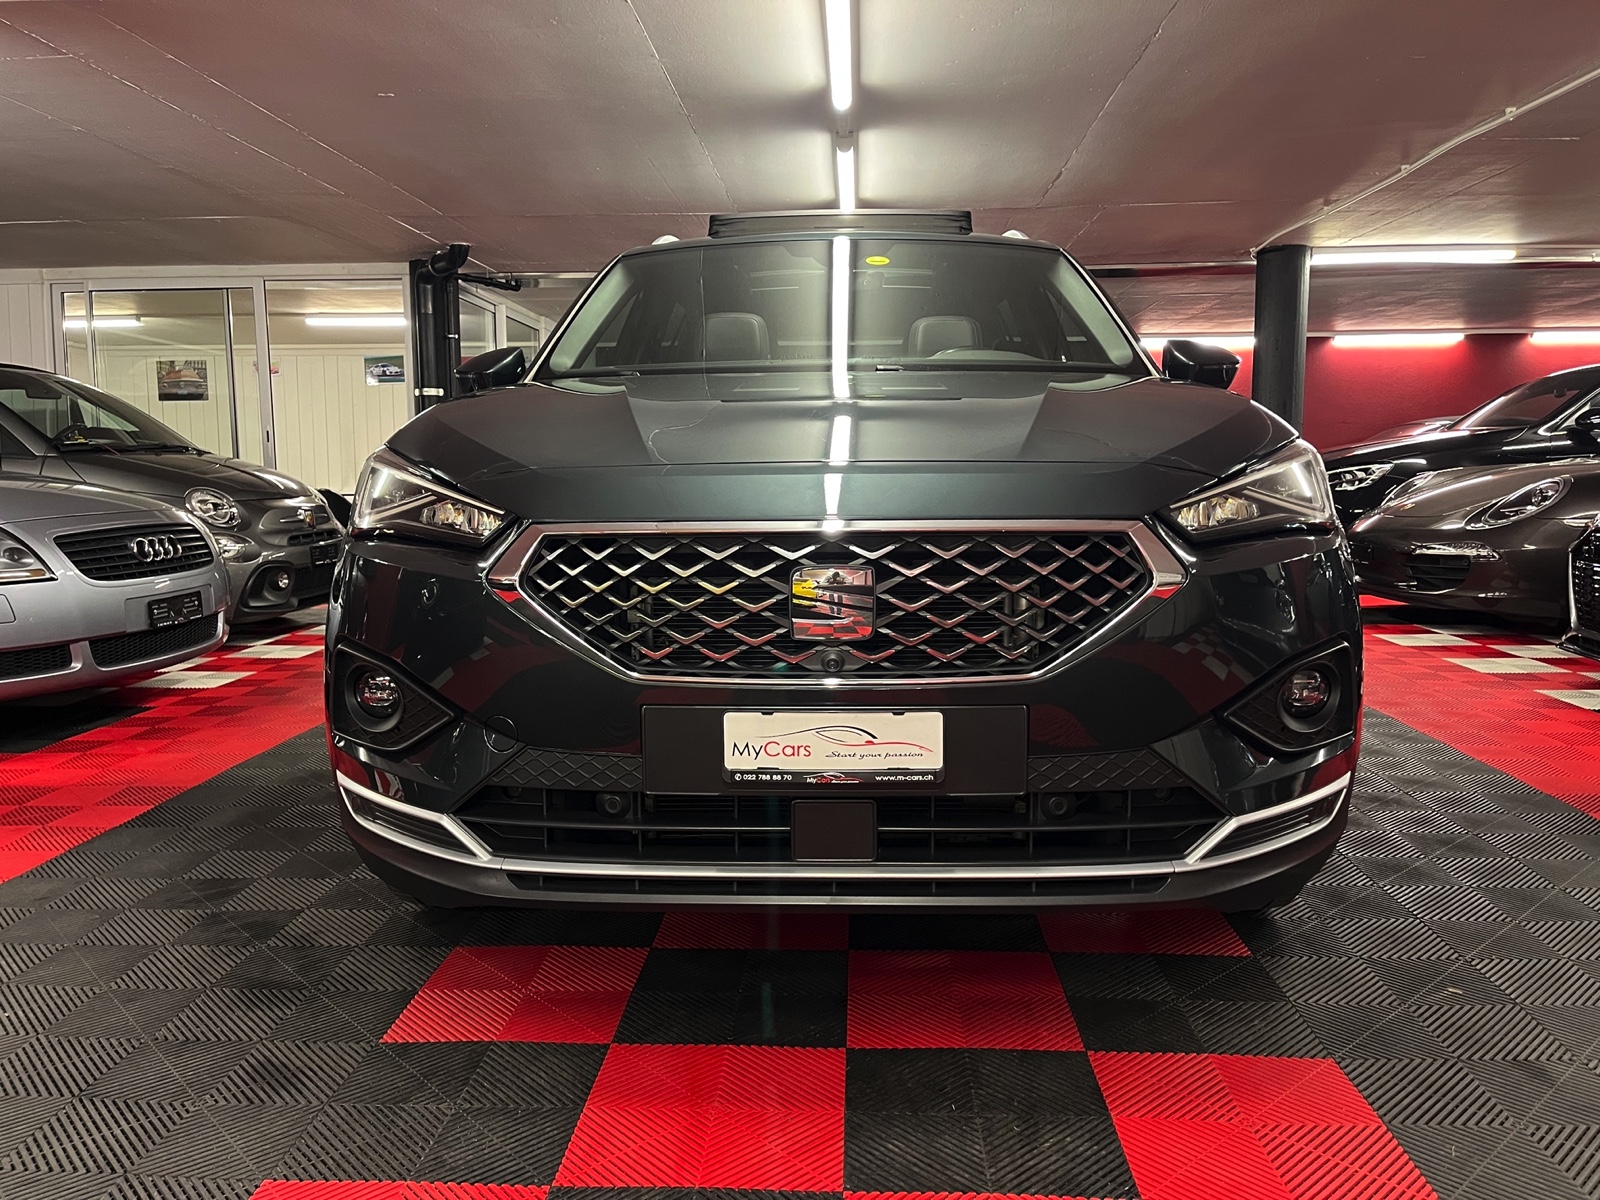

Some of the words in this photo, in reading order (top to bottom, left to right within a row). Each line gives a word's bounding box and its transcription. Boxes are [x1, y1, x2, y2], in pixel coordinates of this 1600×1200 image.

[732, 741, 811, 760] MyCars
[858, 752, 882, 760] your
[884, 751, 924, 759] passion
